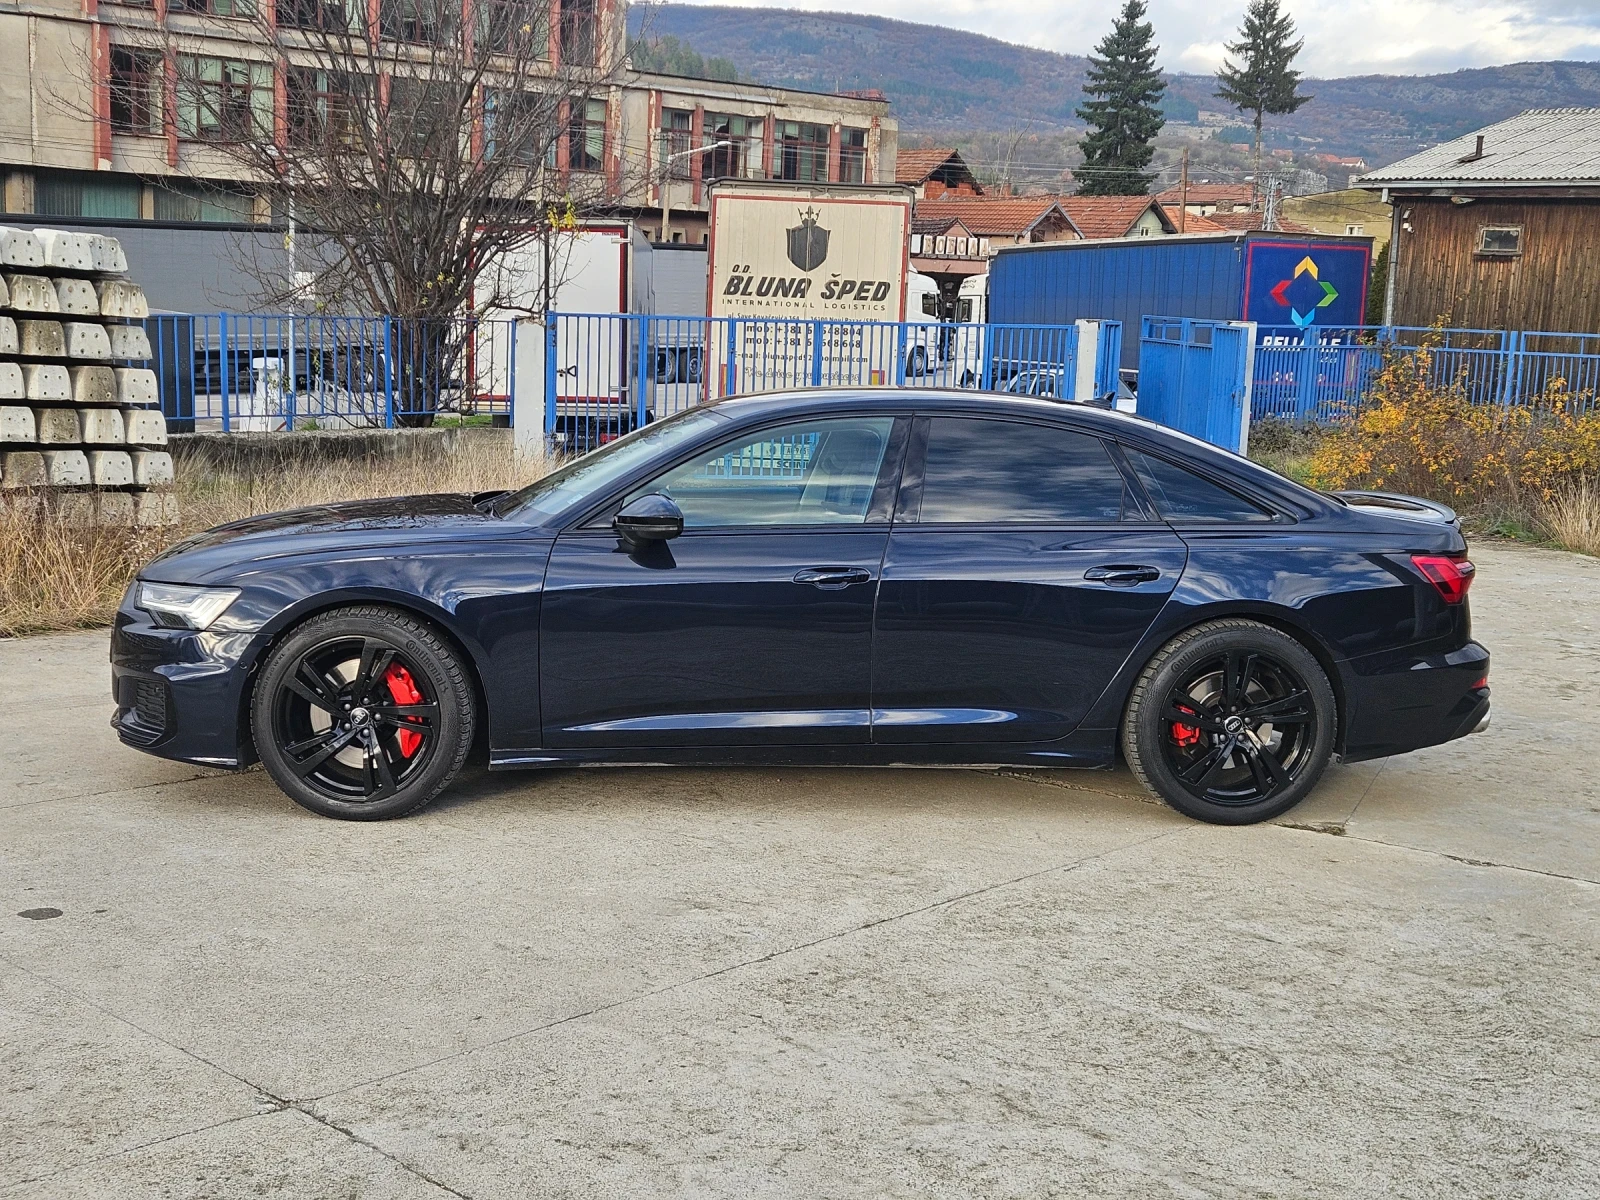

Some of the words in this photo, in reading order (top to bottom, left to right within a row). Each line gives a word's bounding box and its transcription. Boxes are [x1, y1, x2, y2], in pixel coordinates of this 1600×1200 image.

[732, 264, 752, 274] O.D.
[723, 275, 812, 298] BLUNA
[820, 273, 891, 301] ŠPED
[722, 299, 815, 308] INTERNATIONAL
[824, 303, 886, 311] LOGISTICS
[1262, 335, 1342, 353] RELILE
[405, 640, 446, 686] Continental
[1171, 638, 1219, 673] Continental
